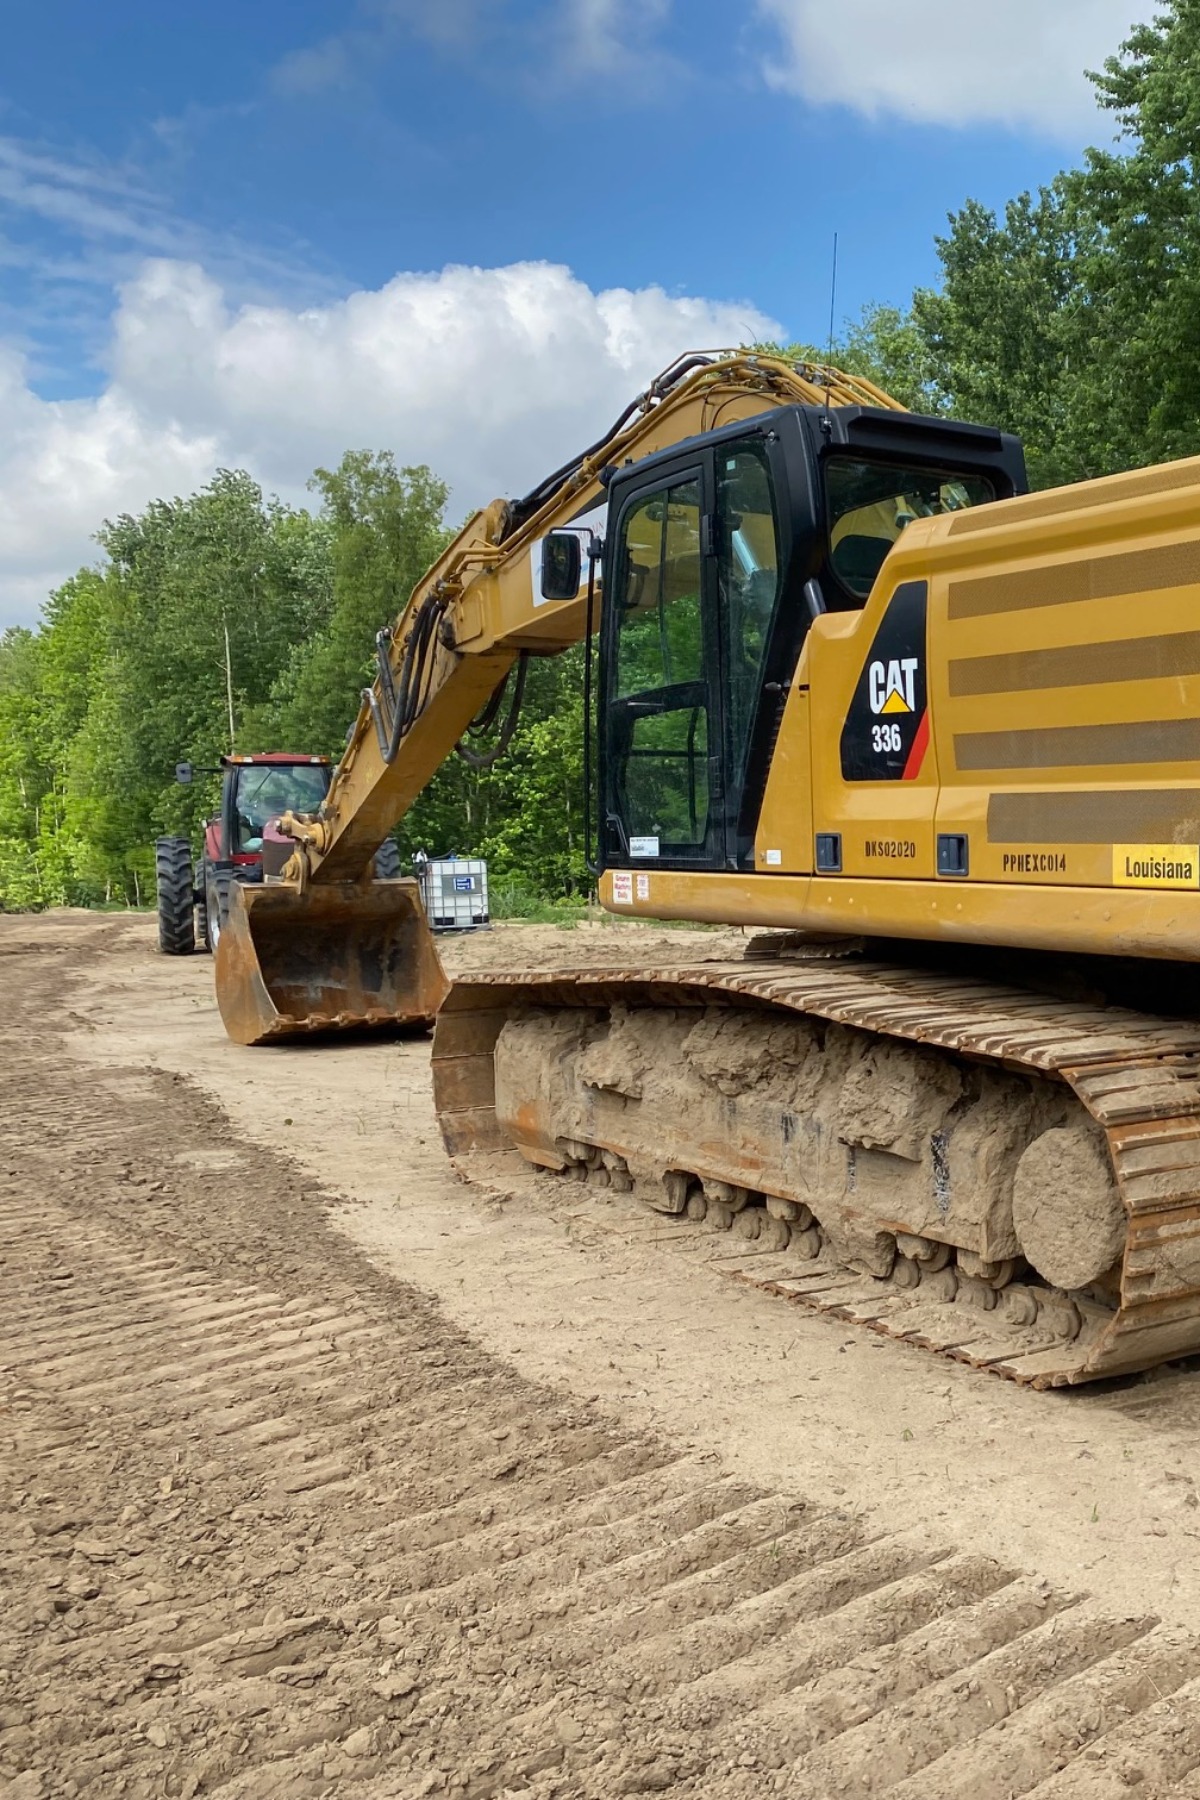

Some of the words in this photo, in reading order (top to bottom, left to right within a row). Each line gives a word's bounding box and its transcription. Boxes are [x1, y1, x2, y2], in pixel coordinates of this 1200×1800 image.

[868, 657, 918, 714] CAT
[871, 723, 902, 752] 336
[1125, 856, 1193, 880] Louisiana
